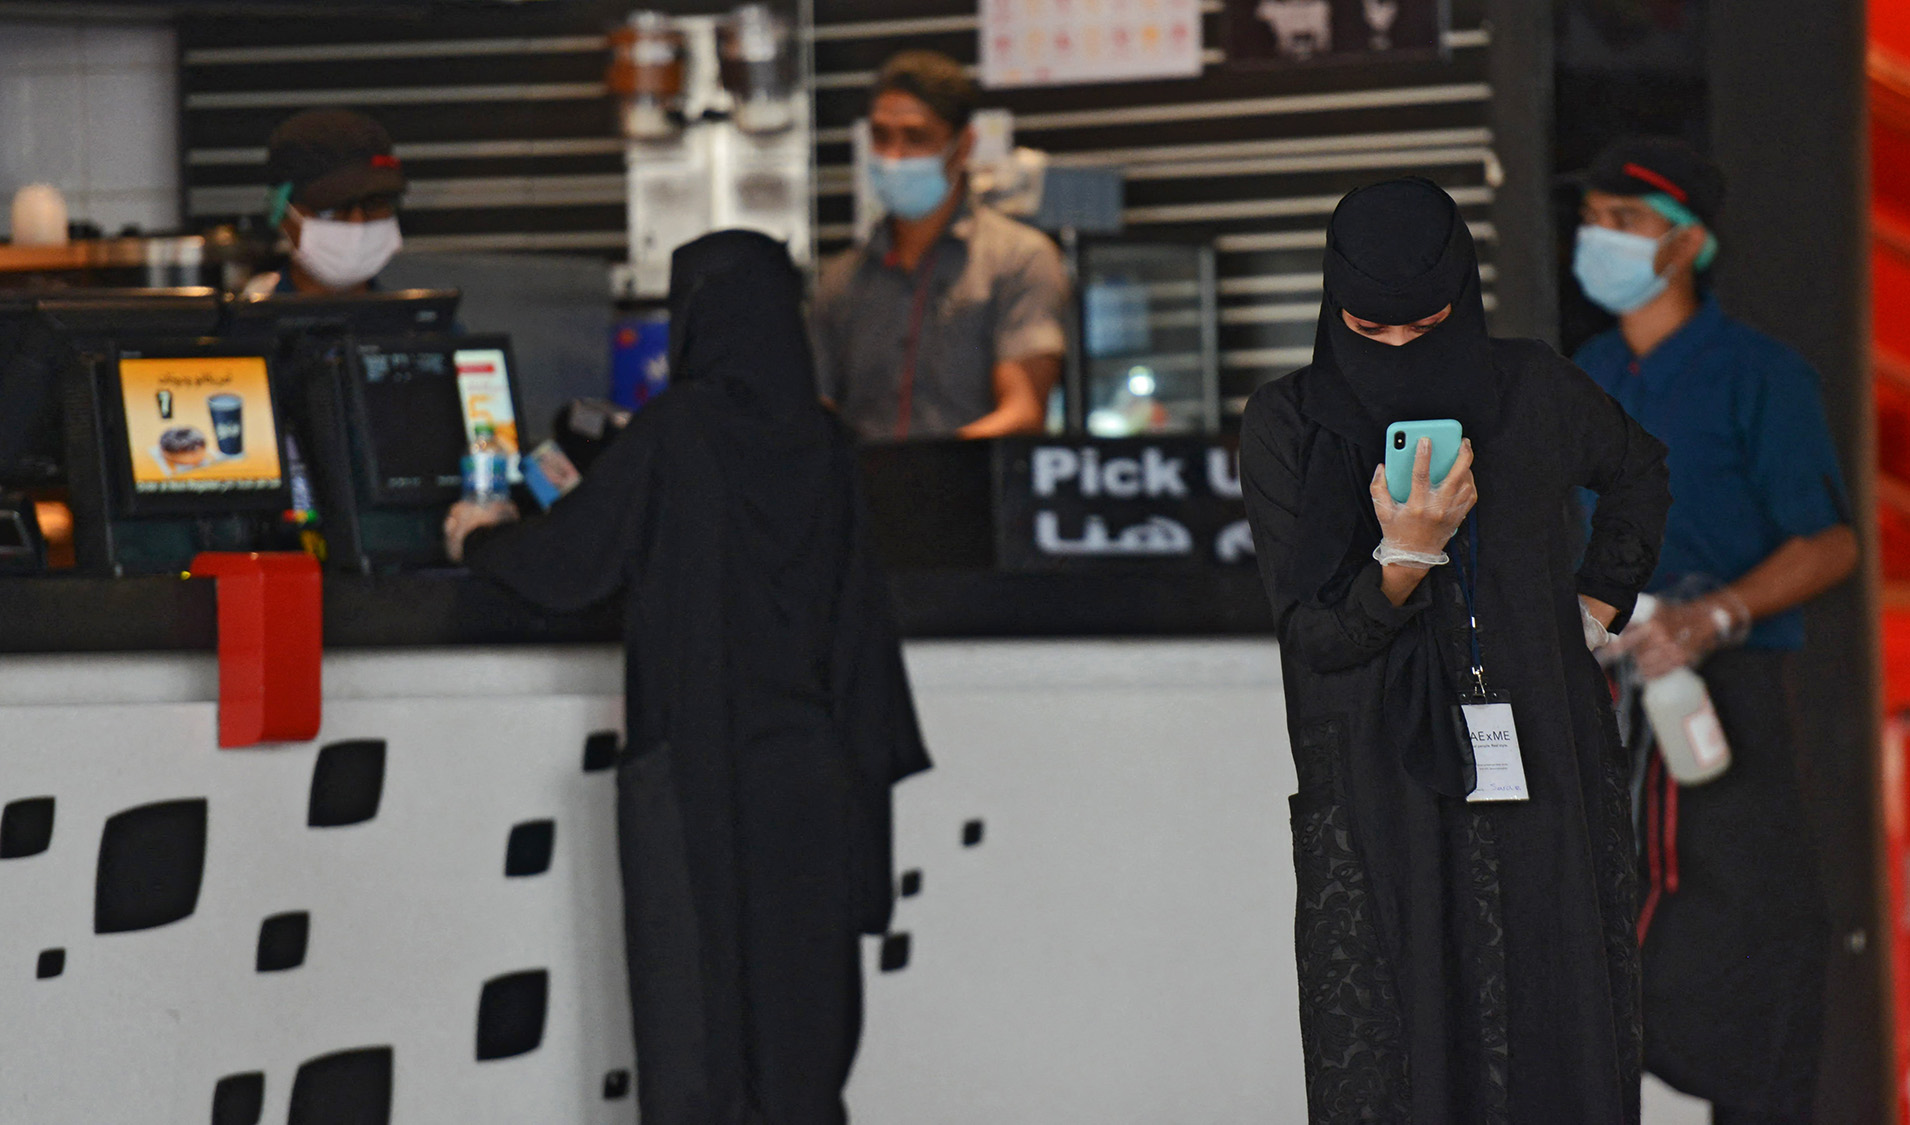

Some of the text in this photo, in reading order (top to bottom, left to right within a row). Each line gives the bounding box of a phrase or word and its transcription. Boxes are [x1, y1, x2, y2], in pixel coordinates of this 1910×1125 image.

[1033, 447, 1243, 496] Pick U
[1036, 511, 1191, 554] هنا
